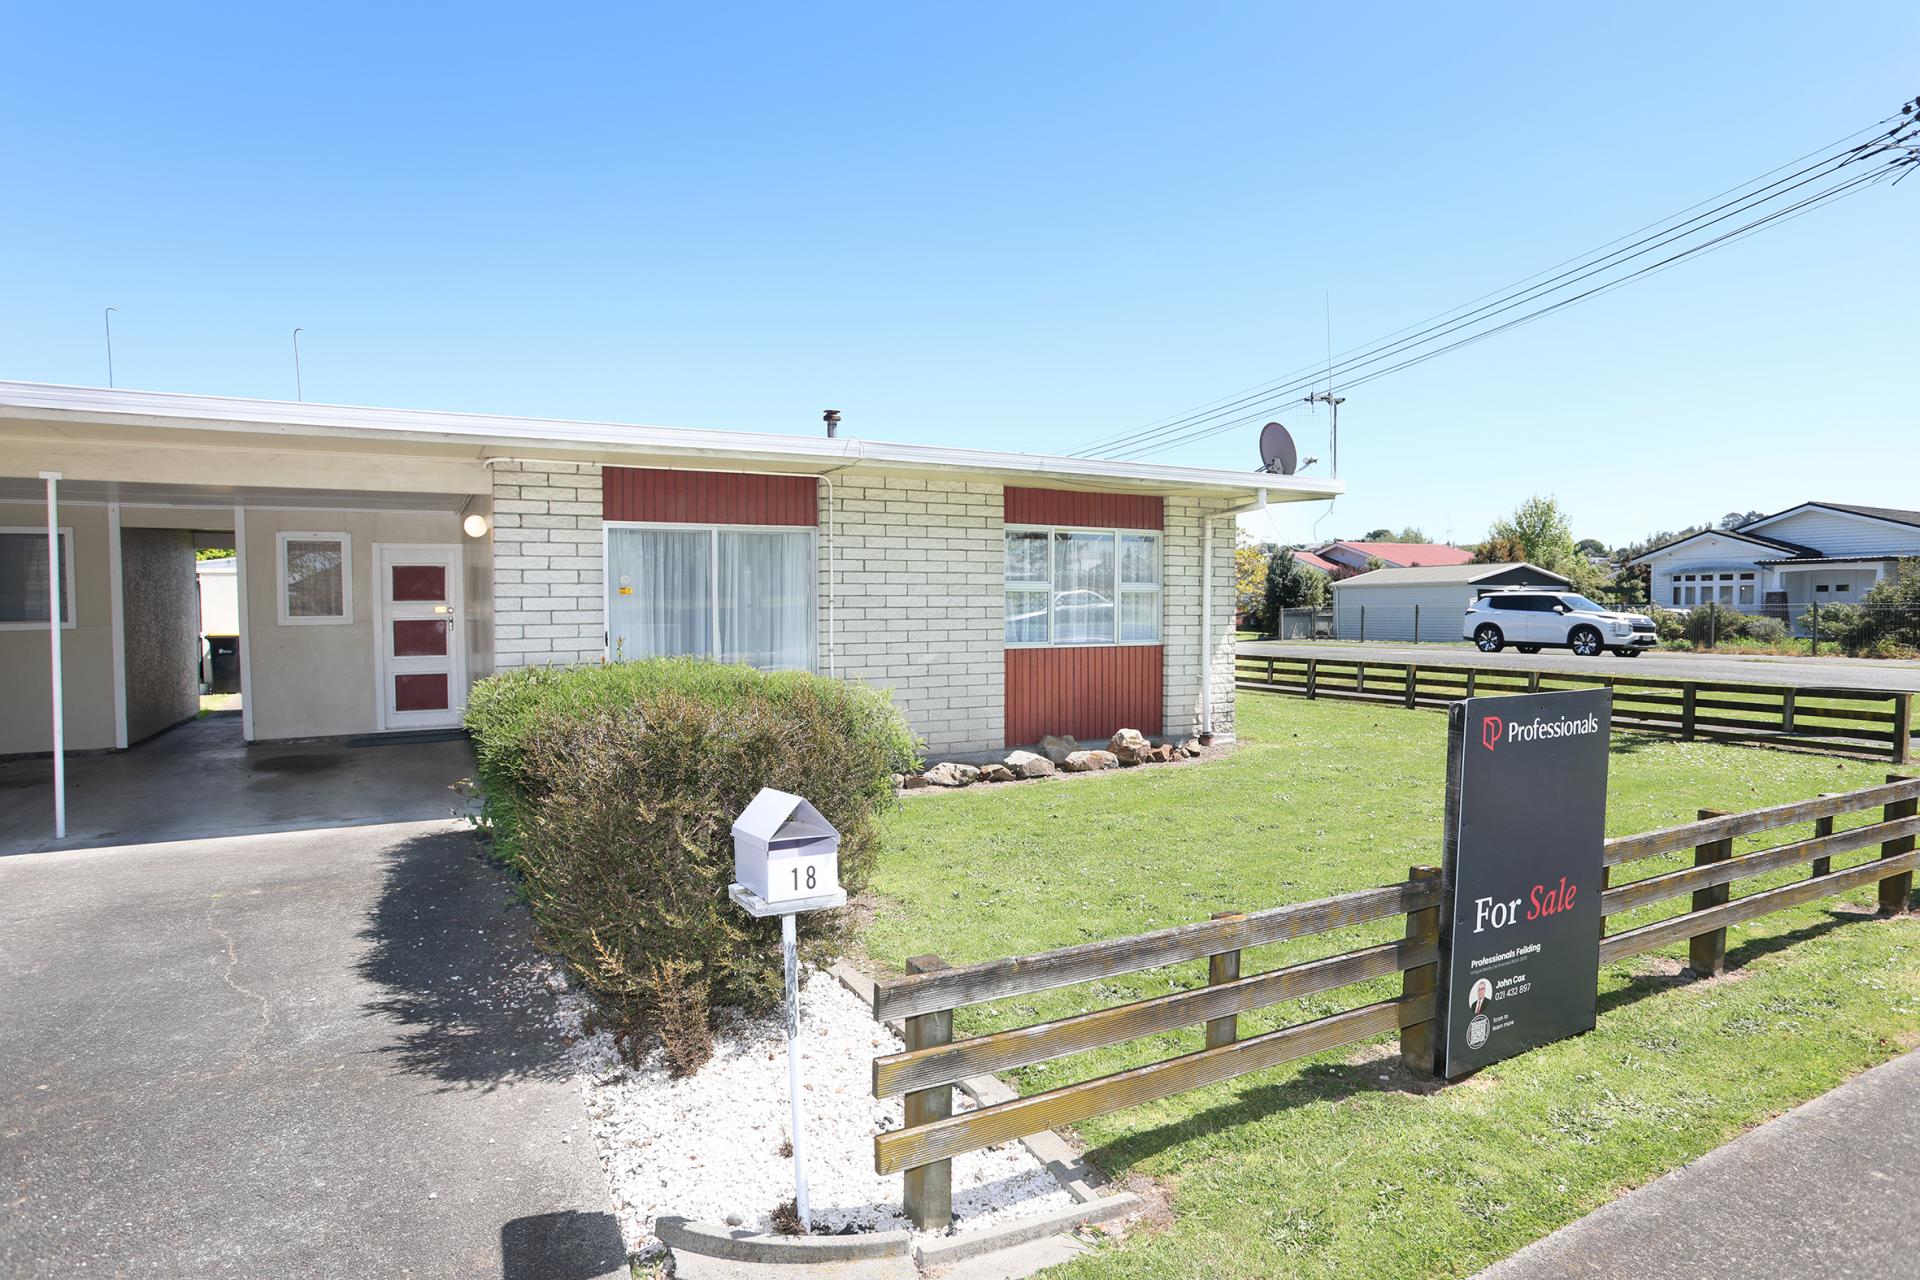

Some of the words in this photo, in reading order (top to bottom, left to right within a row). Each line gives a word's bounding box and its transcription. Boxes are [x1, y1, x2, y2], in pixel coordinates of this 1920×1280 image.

[1508, 712, 1599, 743] Professionals
[791, 865, 817, 892] 18
[1473, 896, 1522, 934] For
[1527, 876, 1577, 921] Sale
[1471, 950, 1515, 968] Professionals
[1494, 990, 1506, 1001] 021
[1506, 986, 1519, 997] 432
[1518, 982, 1531, 994] 897
[1495, 977, 1512, 989] John
[1513, 974, 1526, 984] Cox
